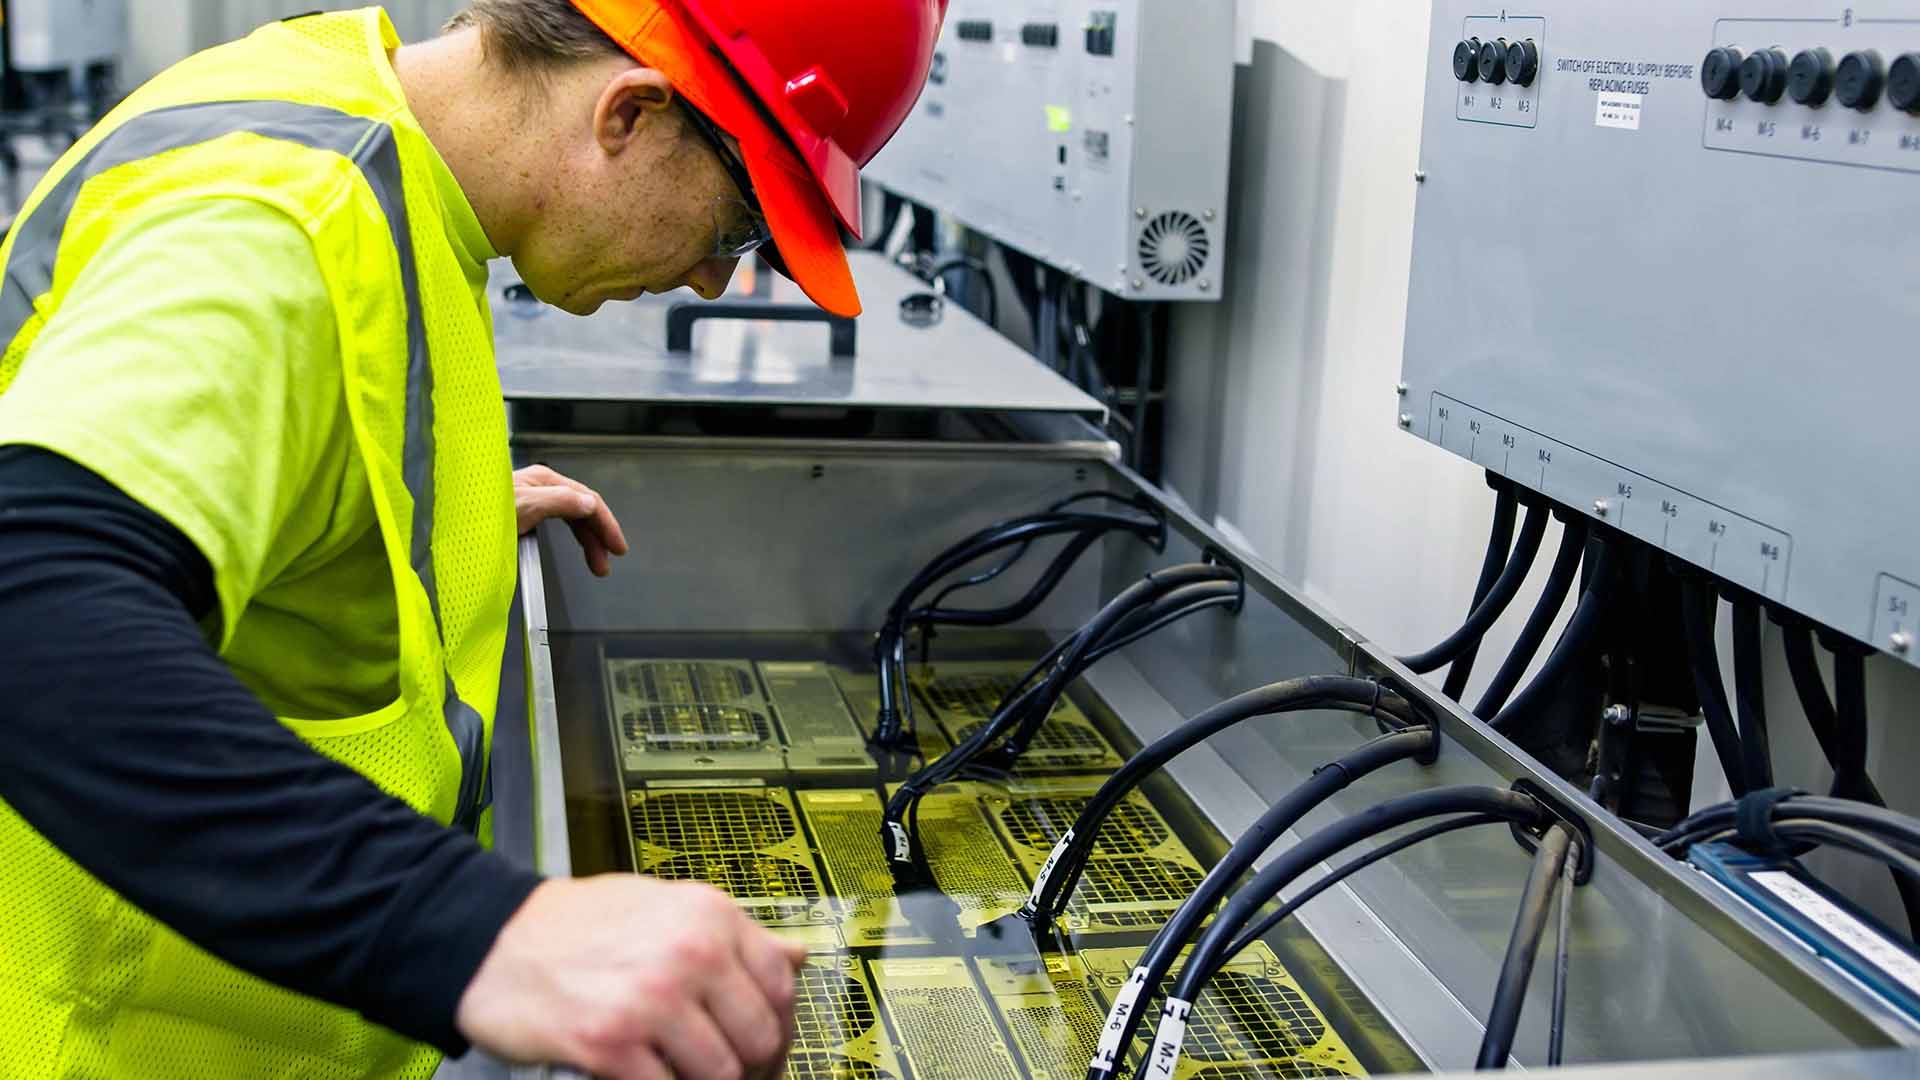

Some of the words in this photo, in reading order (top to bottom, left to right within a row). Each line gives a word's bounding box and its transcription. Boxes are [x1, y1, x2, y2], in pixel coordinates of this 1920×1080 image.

[1499, 9, 1507, 23] A
[1556, 58, 1582, 73] SWITCH
[1582, 60, 1595, 73] OFF
[1596, 61, 1636, 76] ELECTRICAL
[1636, 63, 1663, 77] SUPPLY
[1663, 64, 1694, 79] BEFORE
[1588, 78, 1626, 93] REPLACING
[1627, 81, 1649, 95] FUSES
[1464, 95, 1475, 107] M-1
[1491, 97, 1503, 109] M-2
[1518, 99, 1530, 113] M-3
[1716, 117, 1733, 132] M-4
[1757, 121, 1776, 138] M-5
[1801, 125, 1822, 142] M-6
[1849, 129, 1871, 145] M-7
[1439, 407, 1449, 421] M-1
[1470, 419, 1481, 434] M-2
[1503, 433, 1515, 449] M-3
[1539, 448, 1552, 463] M-4
[1617, 482, 1633, 499] M-5
[1661, 500, 1678, 517] M-6
[1708, 520, 1727, 537] M-7
[1760, 541, 1779, 560] M-8
[1040, 856, 1054, 881] M-5
[1110, 1003, 1130, 1031] M-6
[1156, 1042, 1176, 1075] M-7
